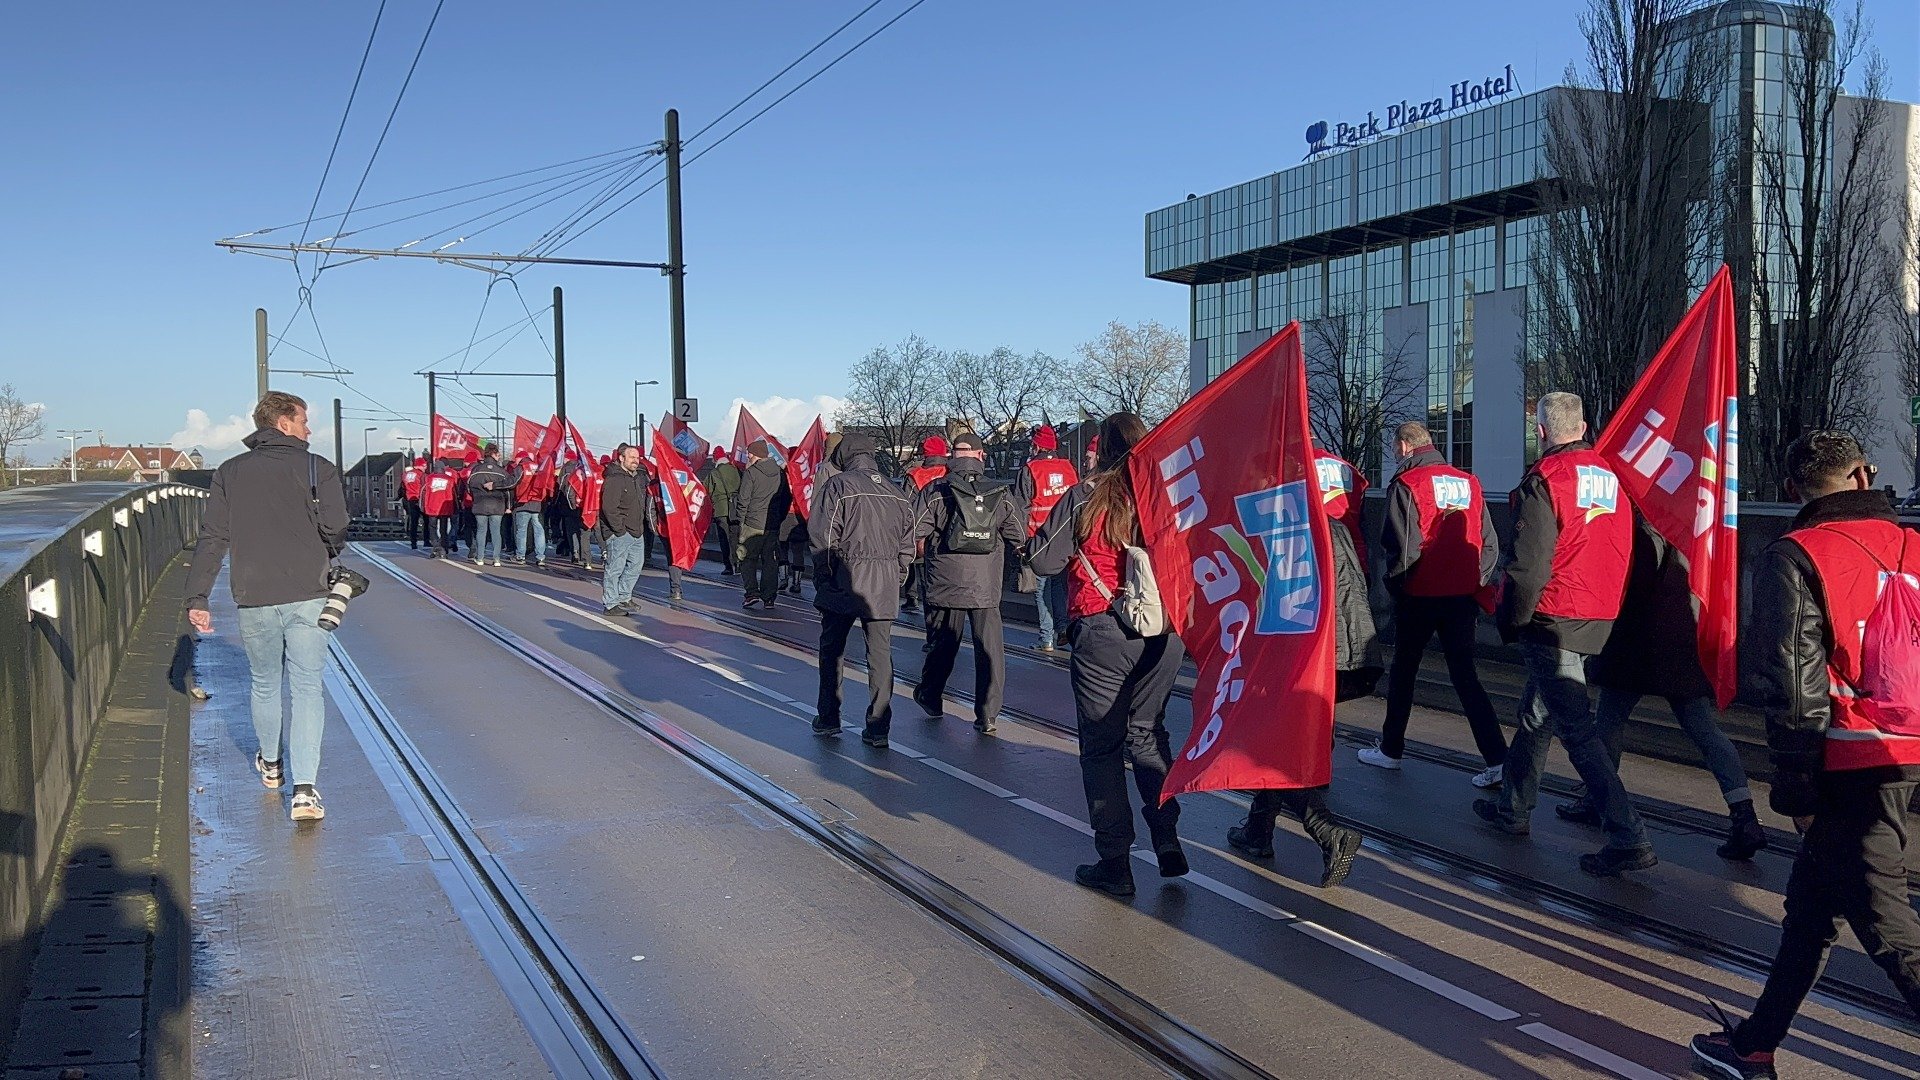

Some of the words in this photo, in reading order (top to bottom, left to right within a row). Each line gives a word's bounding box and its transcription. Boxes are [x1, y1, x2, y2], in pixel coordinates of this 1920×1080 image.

[1336, 111, 1380, 145] Park
[1387, 98, 1445, 130] Plaza
[1450, 63, 1514, 110] Hotel
[681, 403, 691, 417] 2
[1316, 463, 1350, 486] FNV
[1618, 408, 1694, 495] in
[1158, 435, 1209, 533] in
[1435, 480, 1470, 504] FNV
[1580, 474, 1616, 500] FNV
[1255, 491, 1315, 627] FNV
